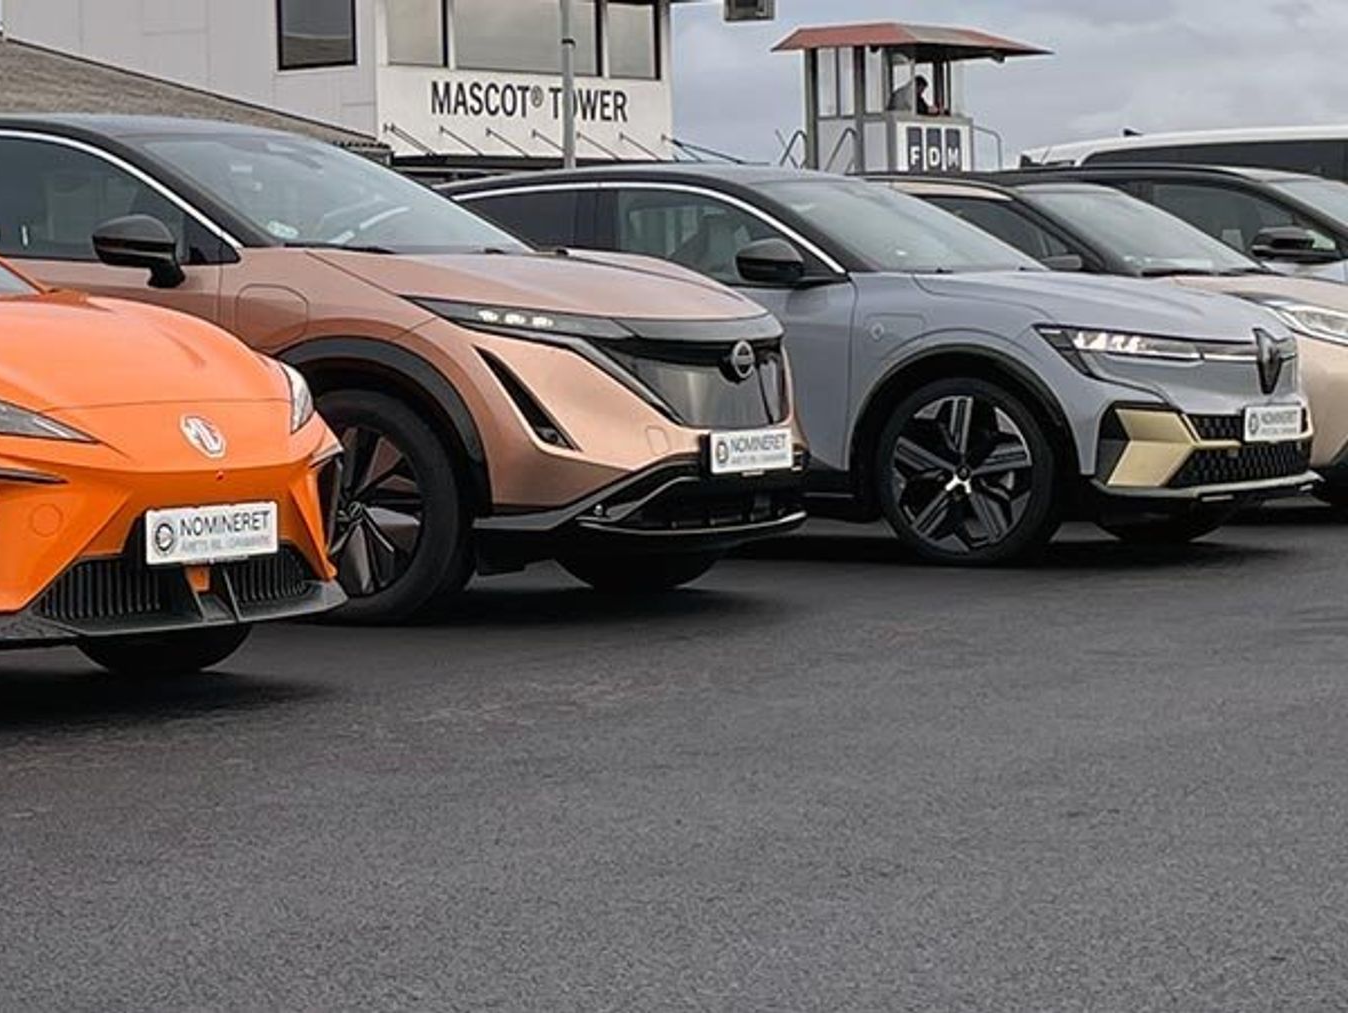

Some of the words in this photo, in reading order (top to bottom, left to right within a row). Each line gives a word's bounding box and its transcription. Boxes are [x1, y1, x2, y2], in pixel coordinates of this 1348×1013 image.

[549, 87, 628, 122] TWER
[910, 146, 959, 167] FDM
[731, 433, 786, 452] NOMINERET
[180, 510, 270, 536] NOMINERET
